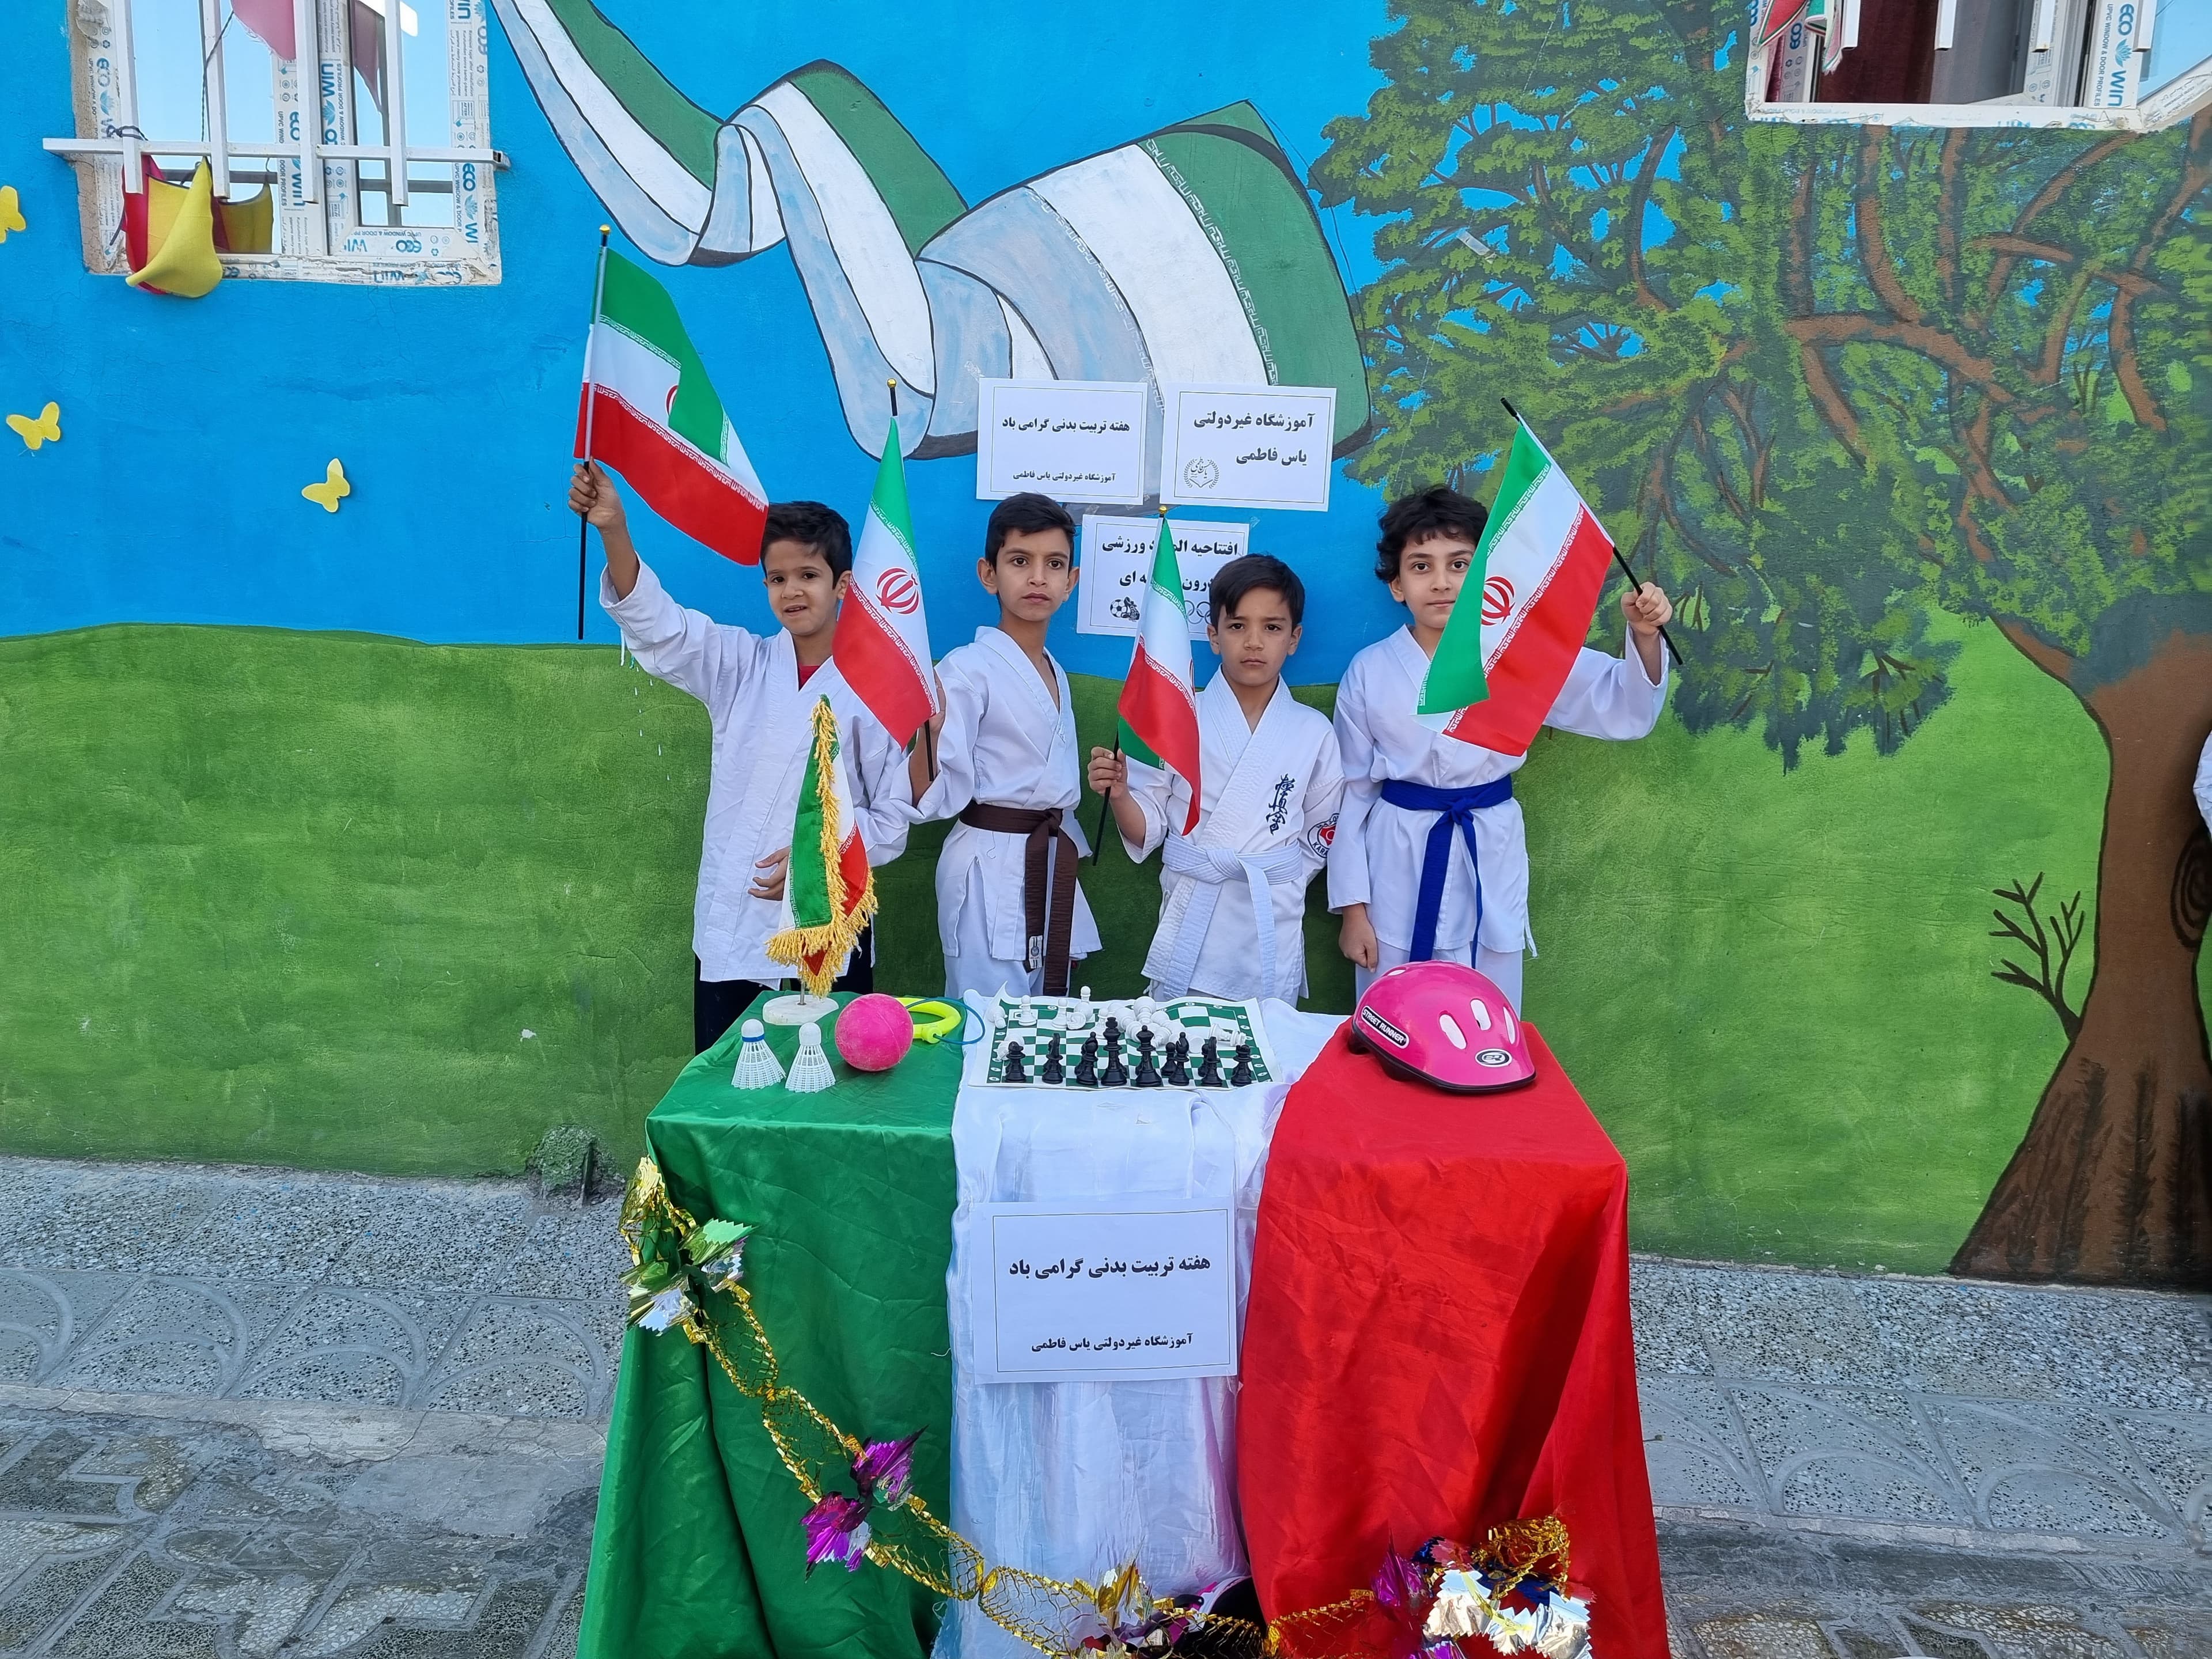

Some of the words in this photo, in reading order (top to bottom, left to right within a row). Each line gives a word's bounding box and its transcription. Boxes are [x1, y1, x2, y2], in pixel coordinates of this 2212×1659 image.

[2105, 3, 2113, 21] UPVC
[2102, 22, 2111, 49] WINDOW
[2099, 56, 2107, 75] DOOR
[2094, 76, 2104, 107] PROFILES
[1002, 416, 1016, 430] باد
[1018, 418, 1050, 431] گرامی
[1052, 418, 1076, 432] بدنی
[1079, 421, 1107, 433] تربیت
[1109, 421, 1130, 431] هفته
[1256, 413, 1315, 431] آموزشگاه
[1236, 448, 1278, 464] فاطمی
[1281, 449, 1307, 465] یاس
[1013, 470, 1035, 479] فاطمی
[1037, 471, 1051, 480] یاس
[1085, 472, 1116, 483] آموزشگاه
[1102, 536, 1146, 554] ورزشی
[1191, 541, 1237, 556] افتتاحیه
[1119, 571, 1136, 586] ای
[1362, 1009, 1381, 1027] STREET
[1379, 1017, 1404, 1044] RUNNER
[1009, 1259, 1030, 1279] باد
[1035, 1258, 1084, 1279] گرامی
[1089, 1257, 1126, 1278] بدنی
[1132, 1256, 1175, 1278] تربیت
[1179, 1255, 1211, 1271] هفته
[1032, 1337, 1066, 1352] فاطمی
[1069, 1338, 1090, 1351] یاس
[1145, 1333, 1193, 1349] آموزشگاه
